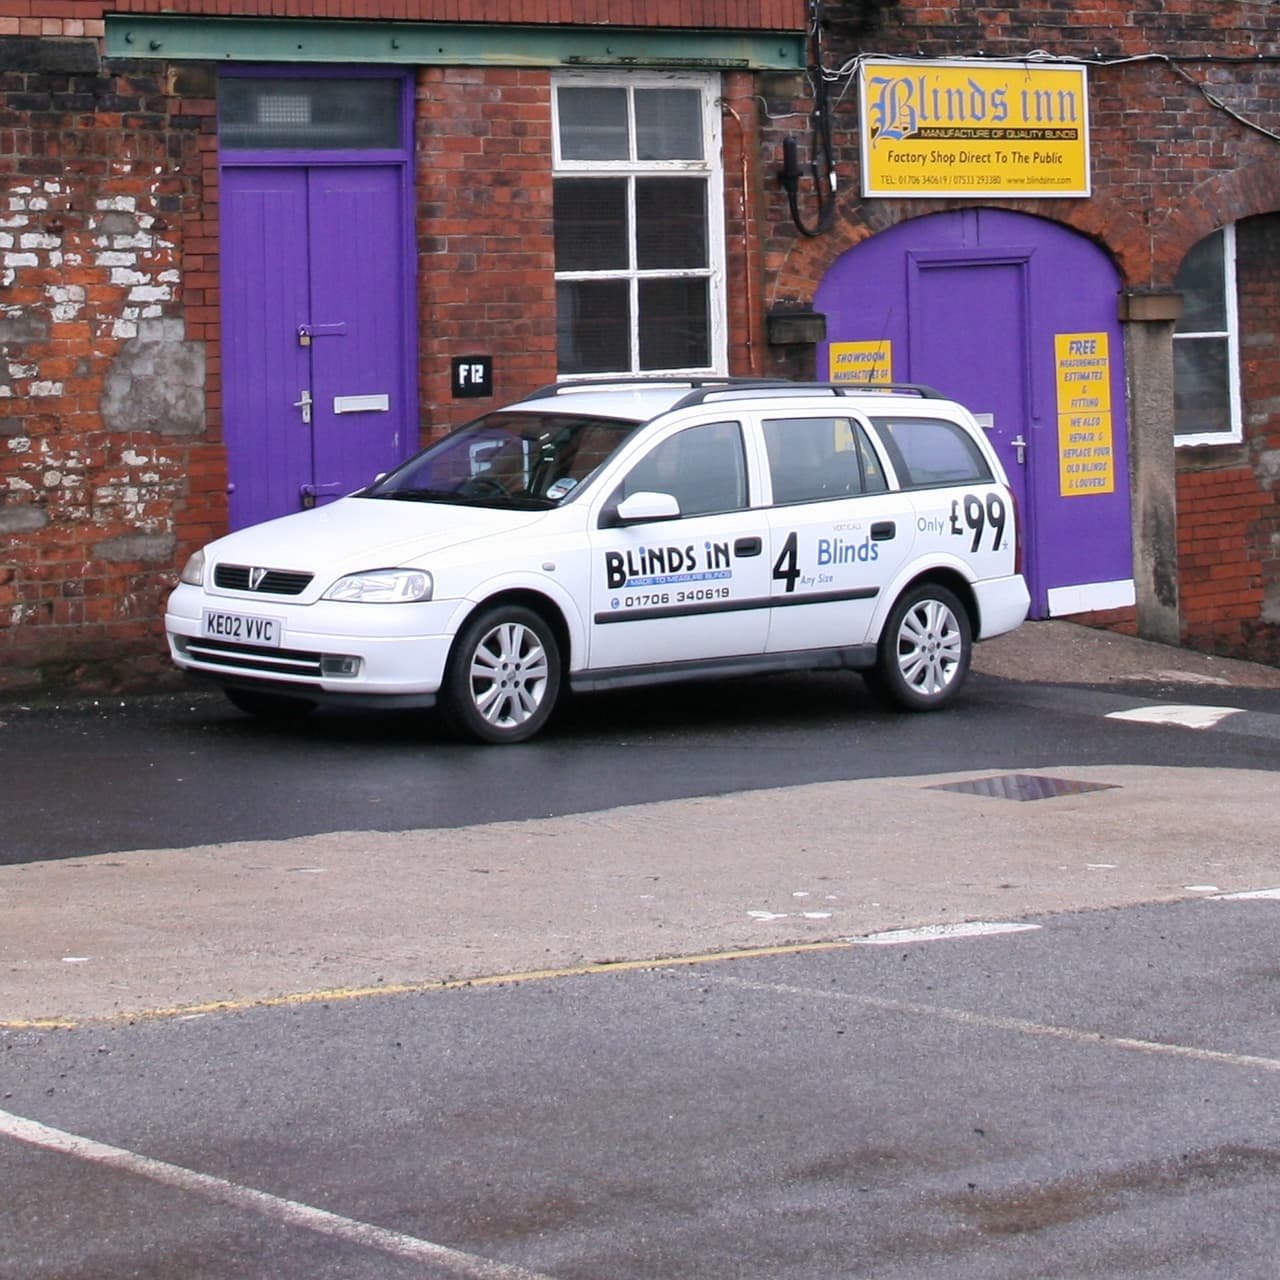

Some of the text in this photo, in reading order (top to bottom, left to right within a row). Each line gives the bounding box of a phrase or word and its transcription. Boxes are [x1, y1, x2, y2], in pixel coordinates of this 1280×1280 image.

[1021, 77, 1078, 122] inn
[921, 129, 1077, 139] MANUFACTURE OF QUALITY BLINDS
[888, 150, 1063, 165] Factory Shop Direct To The Public
[1069, 340, 1096, 355] FREE
[836, 352, 886, 363] SHOWROOM
[1064, 371, 1103, 382] ESTIMATES
[917, 517, 944, 535] Only
[772, 532, 879, 592] 4 Blinds
[800, 574, 833, 586] Any Size
[625, 588, 730, 607] 01706 340619
[207, 613, 273, 640] KE02 VVC
